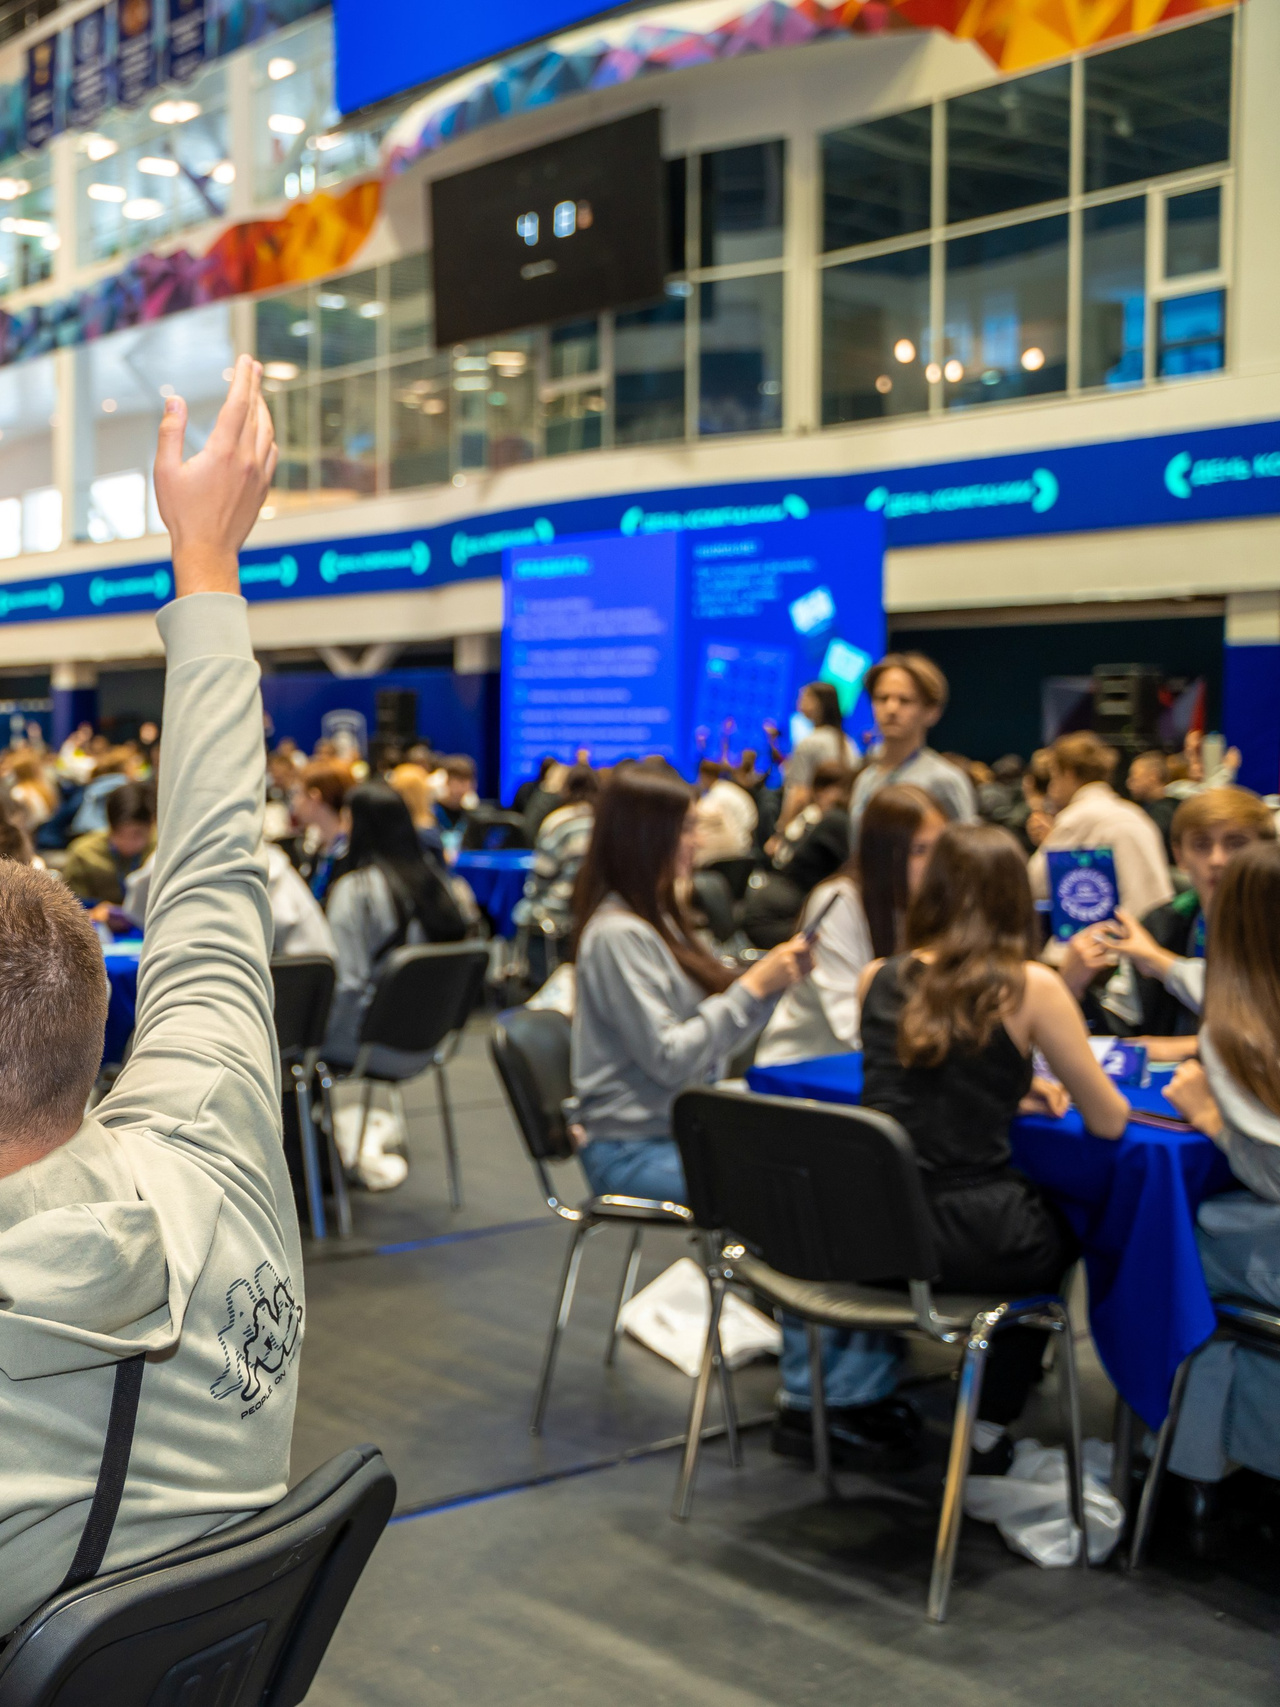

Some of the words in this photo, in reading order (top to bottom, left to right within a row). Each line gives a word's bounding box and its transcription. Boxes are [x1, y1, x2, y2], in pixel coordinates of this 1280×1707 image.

[1102, 1049, 1126, 1076] 2
[240, 1385, 273, 1420] PEOPLE
[274, 1369, 286, 1385] ON
